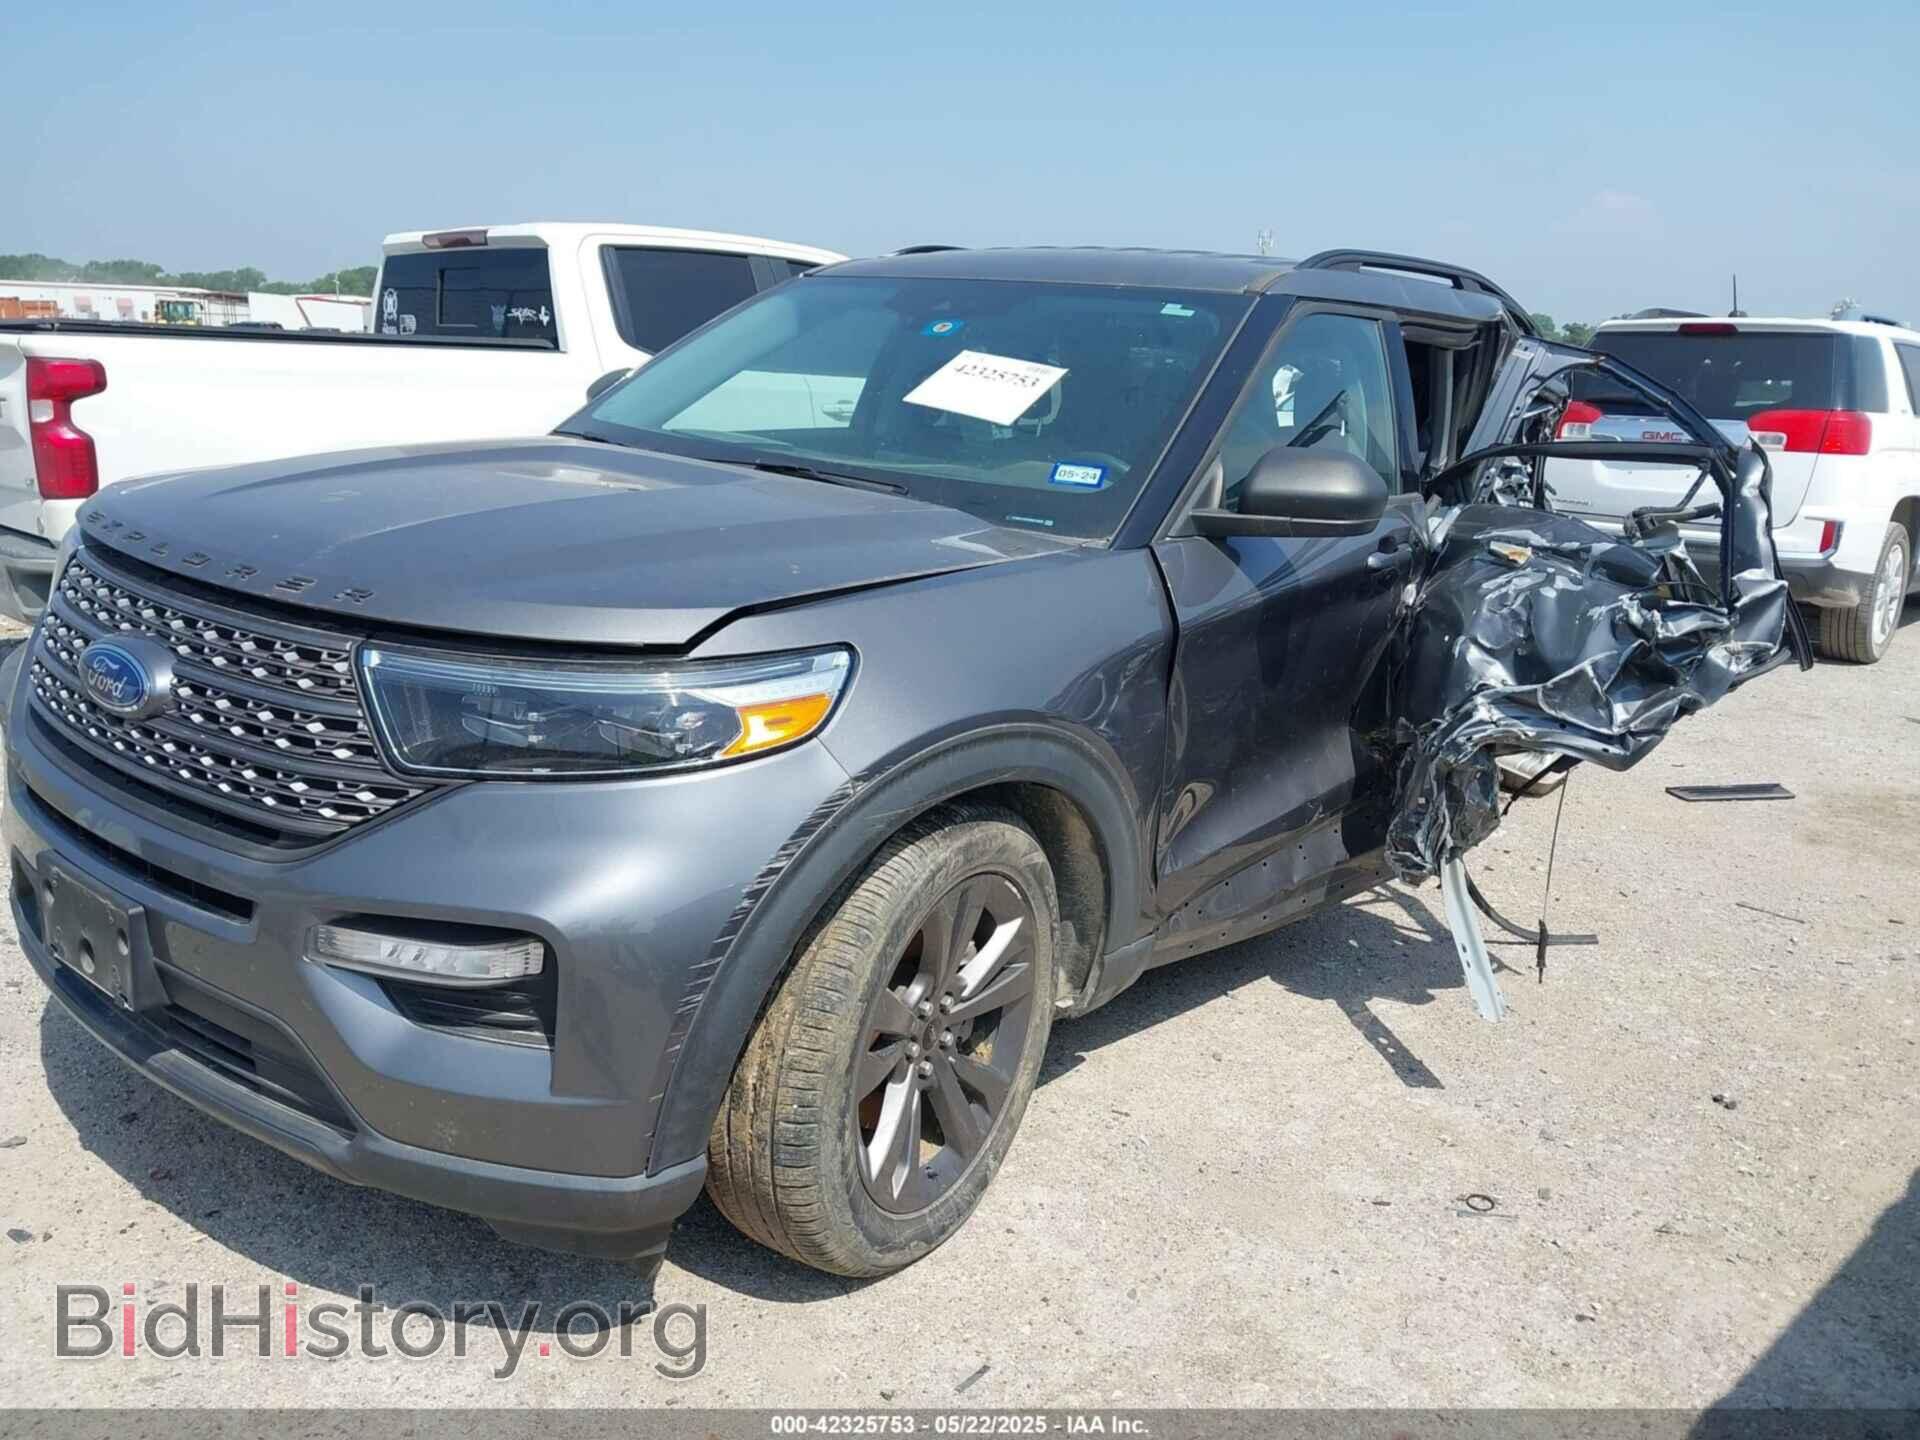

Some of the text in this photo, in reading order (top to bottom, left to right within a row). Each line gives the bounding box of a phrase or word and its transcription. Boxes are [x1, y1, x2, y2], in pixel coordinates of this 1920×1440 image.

[1642, 431, 1684, 441] GMC
[1058, 469, 1098, 481] 05-24
[87, 511, 375, 602] EXPLORER
[88, 656, 127, 698] Ford
